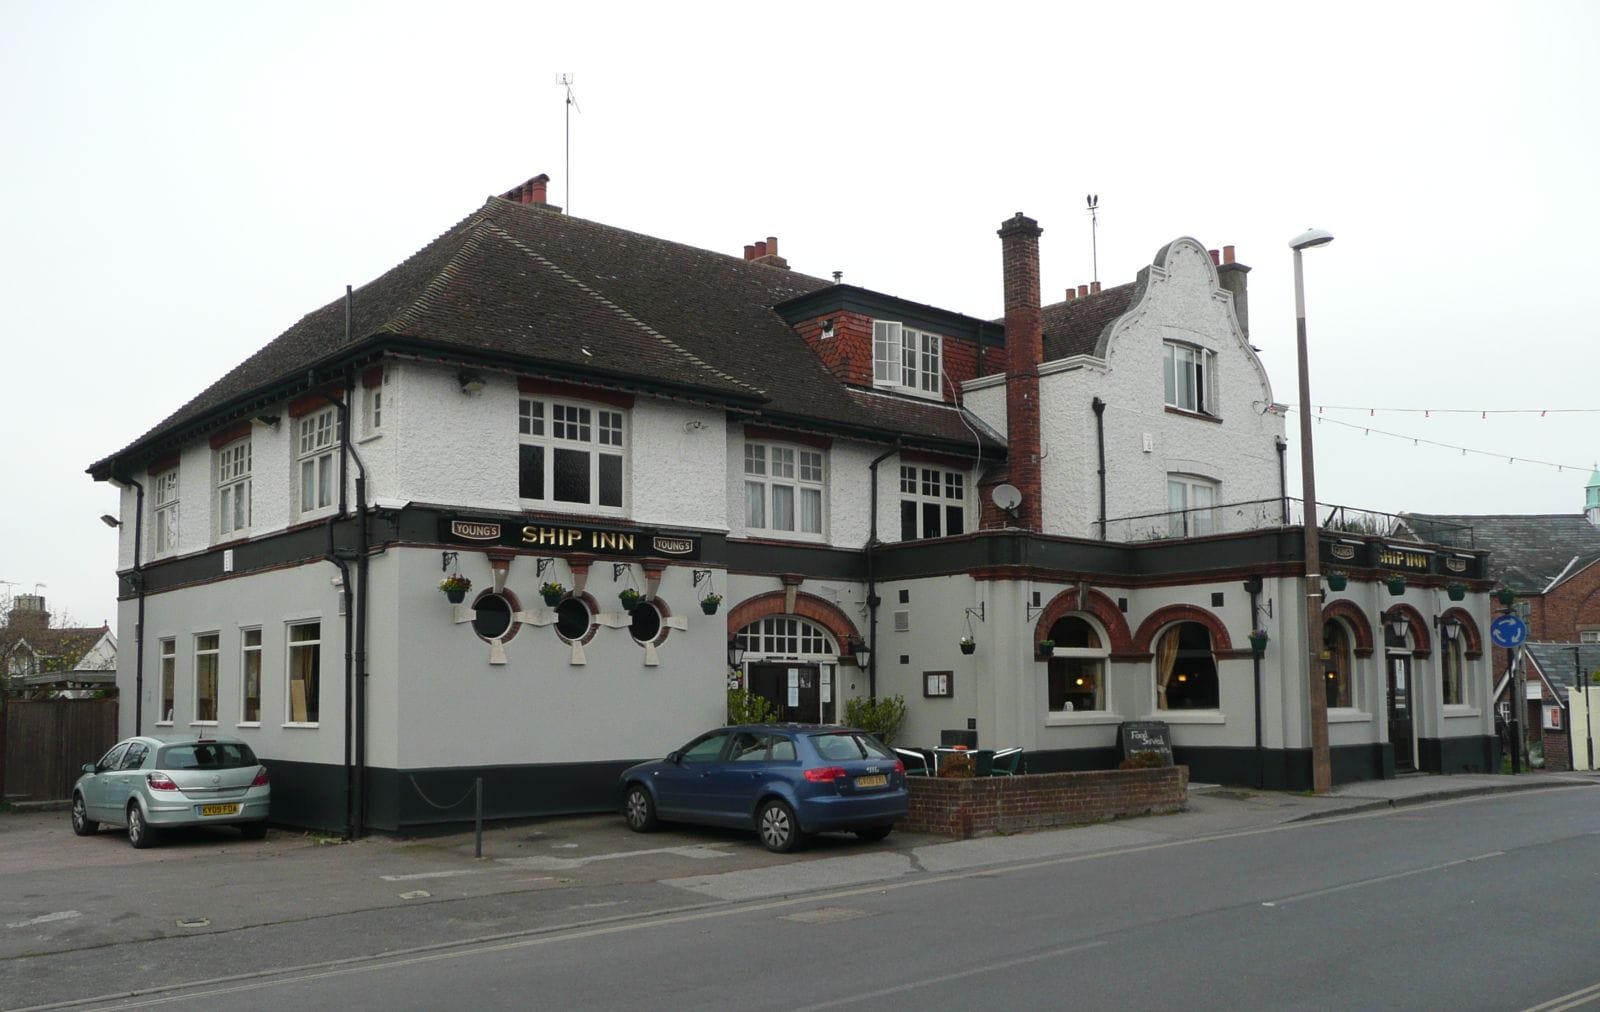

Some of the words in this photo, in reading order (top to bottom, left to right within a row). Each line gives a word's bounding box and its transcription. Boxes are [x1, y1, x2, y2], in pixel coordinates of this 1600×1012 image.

[456, 523, 497, 536] YOUNG'S
[522, 526, 582, 546] SHIP
[592, 531, 634, 550] INN
[656, 539, 690, 551] YOUNG'S
[1380, 551, 1404, 565] SHIP
[1406, 553, 1427, 568] INN
[1131, 730, 1149, 739] Food
